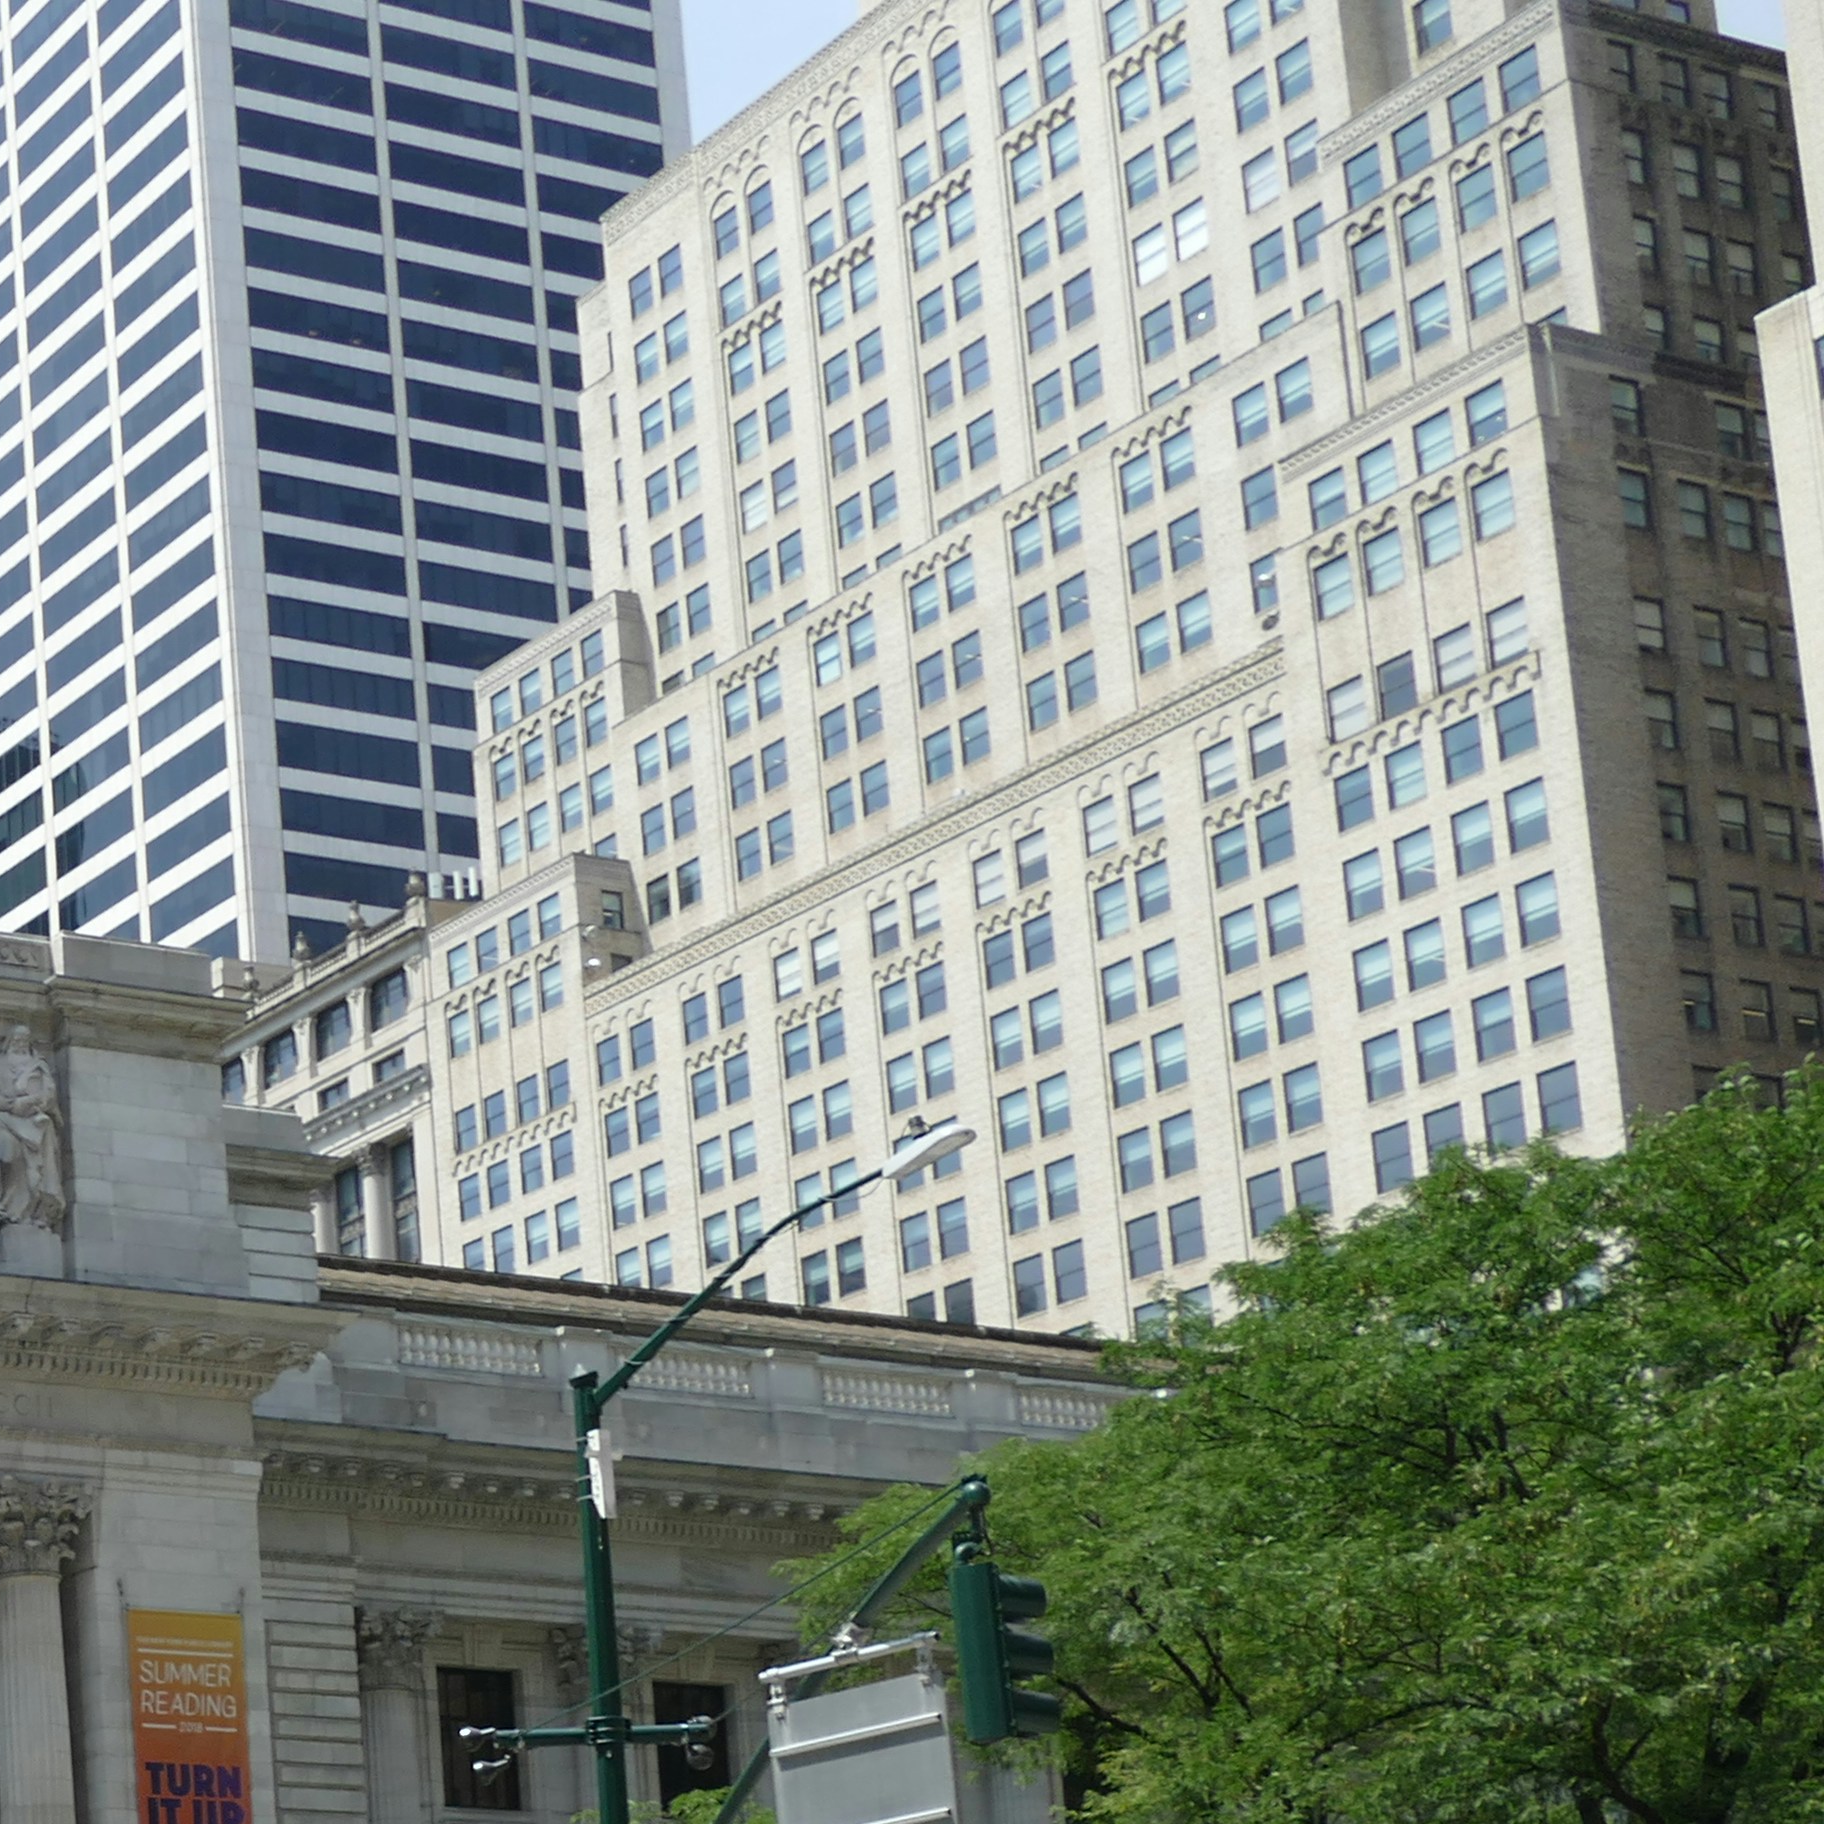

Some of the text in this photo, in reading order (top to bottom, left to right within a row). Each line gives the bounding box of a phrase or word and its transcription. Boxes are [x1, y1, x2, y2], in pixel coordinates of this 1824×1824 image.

[138, 1659, 233, 1688] SUMMER
[140, 1688, 238, 1719] READING
[144, 1761, 243, 1800] TURN
